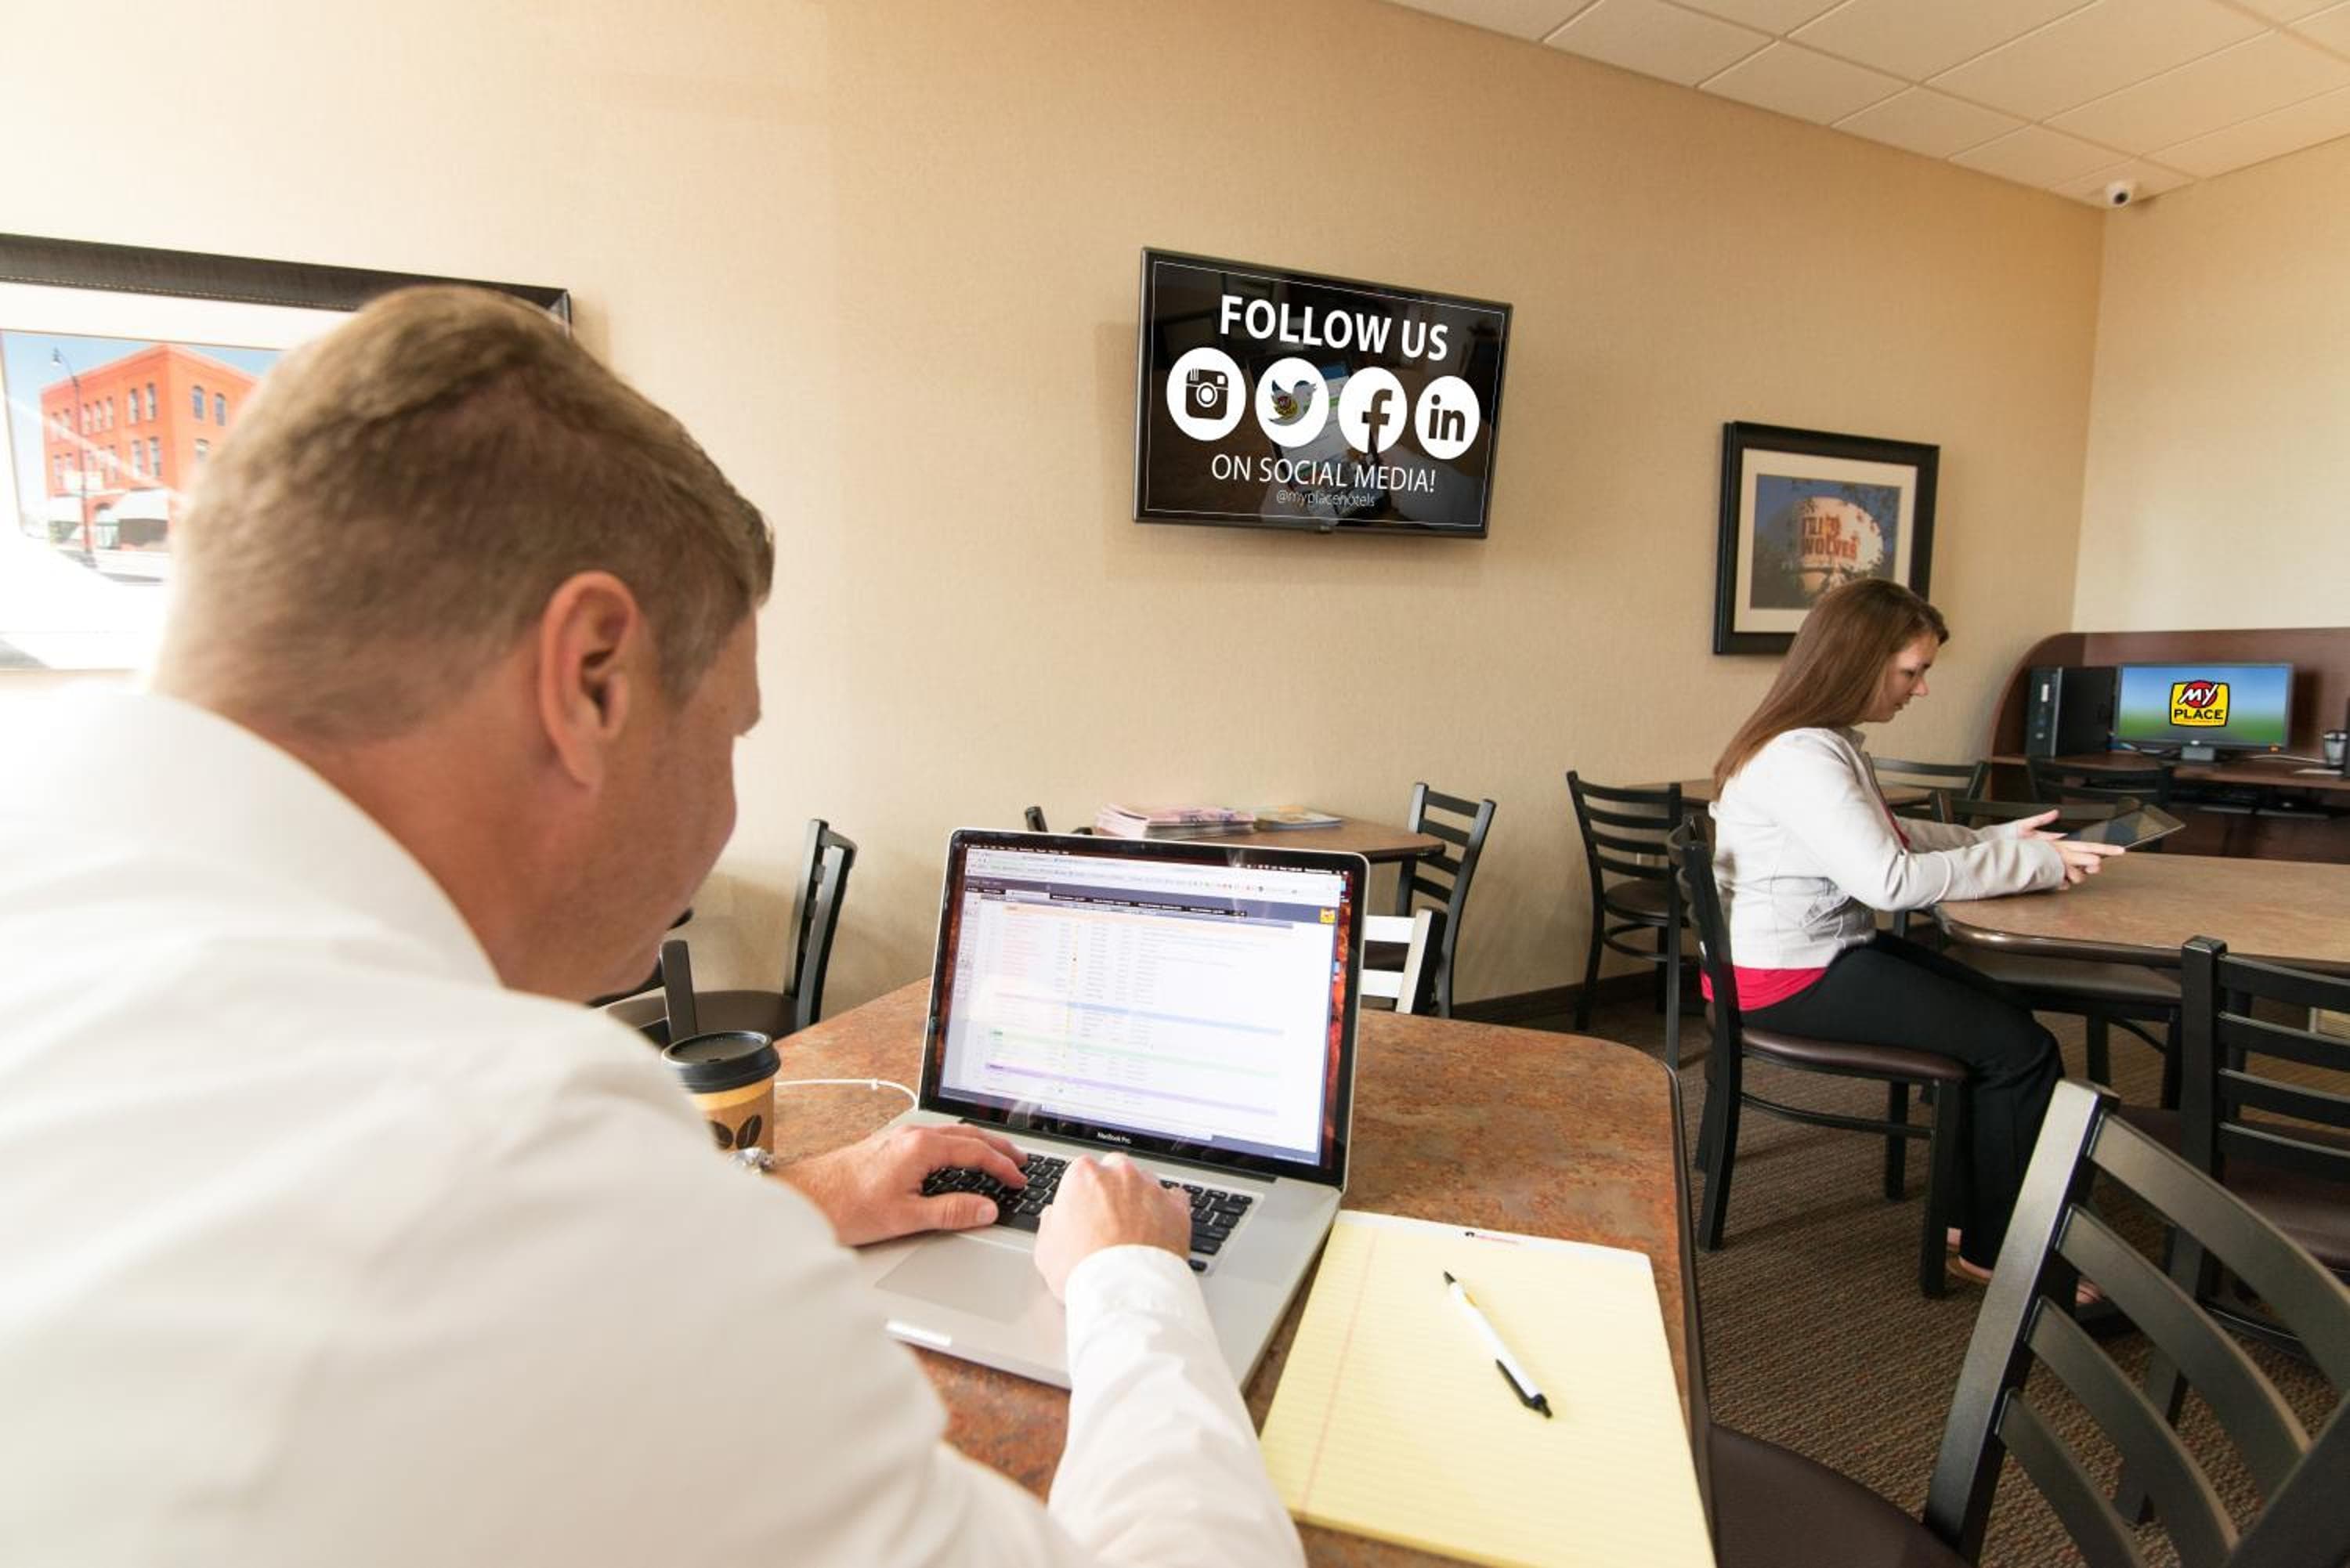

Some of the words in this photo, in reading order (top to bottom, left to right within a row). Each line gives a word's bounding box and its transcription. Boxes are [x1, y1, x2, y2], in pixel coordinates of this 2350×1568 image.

[1220, 294, 1392, 353] FOLLOW
[1401, 320, 1448, 361] US
[1361, 388, 1394, 453] f
[1428, 394, 1466, 442] in
[1211, 453, 1251, 481] ON
[1259, 457, 1348, 487] SOCIAL
[1354, 464, 1436, 493] MEDIA!
[1276, 490, 1376, 508] @myplacehotels
[2174, 709, 2224, 720] PLACE
